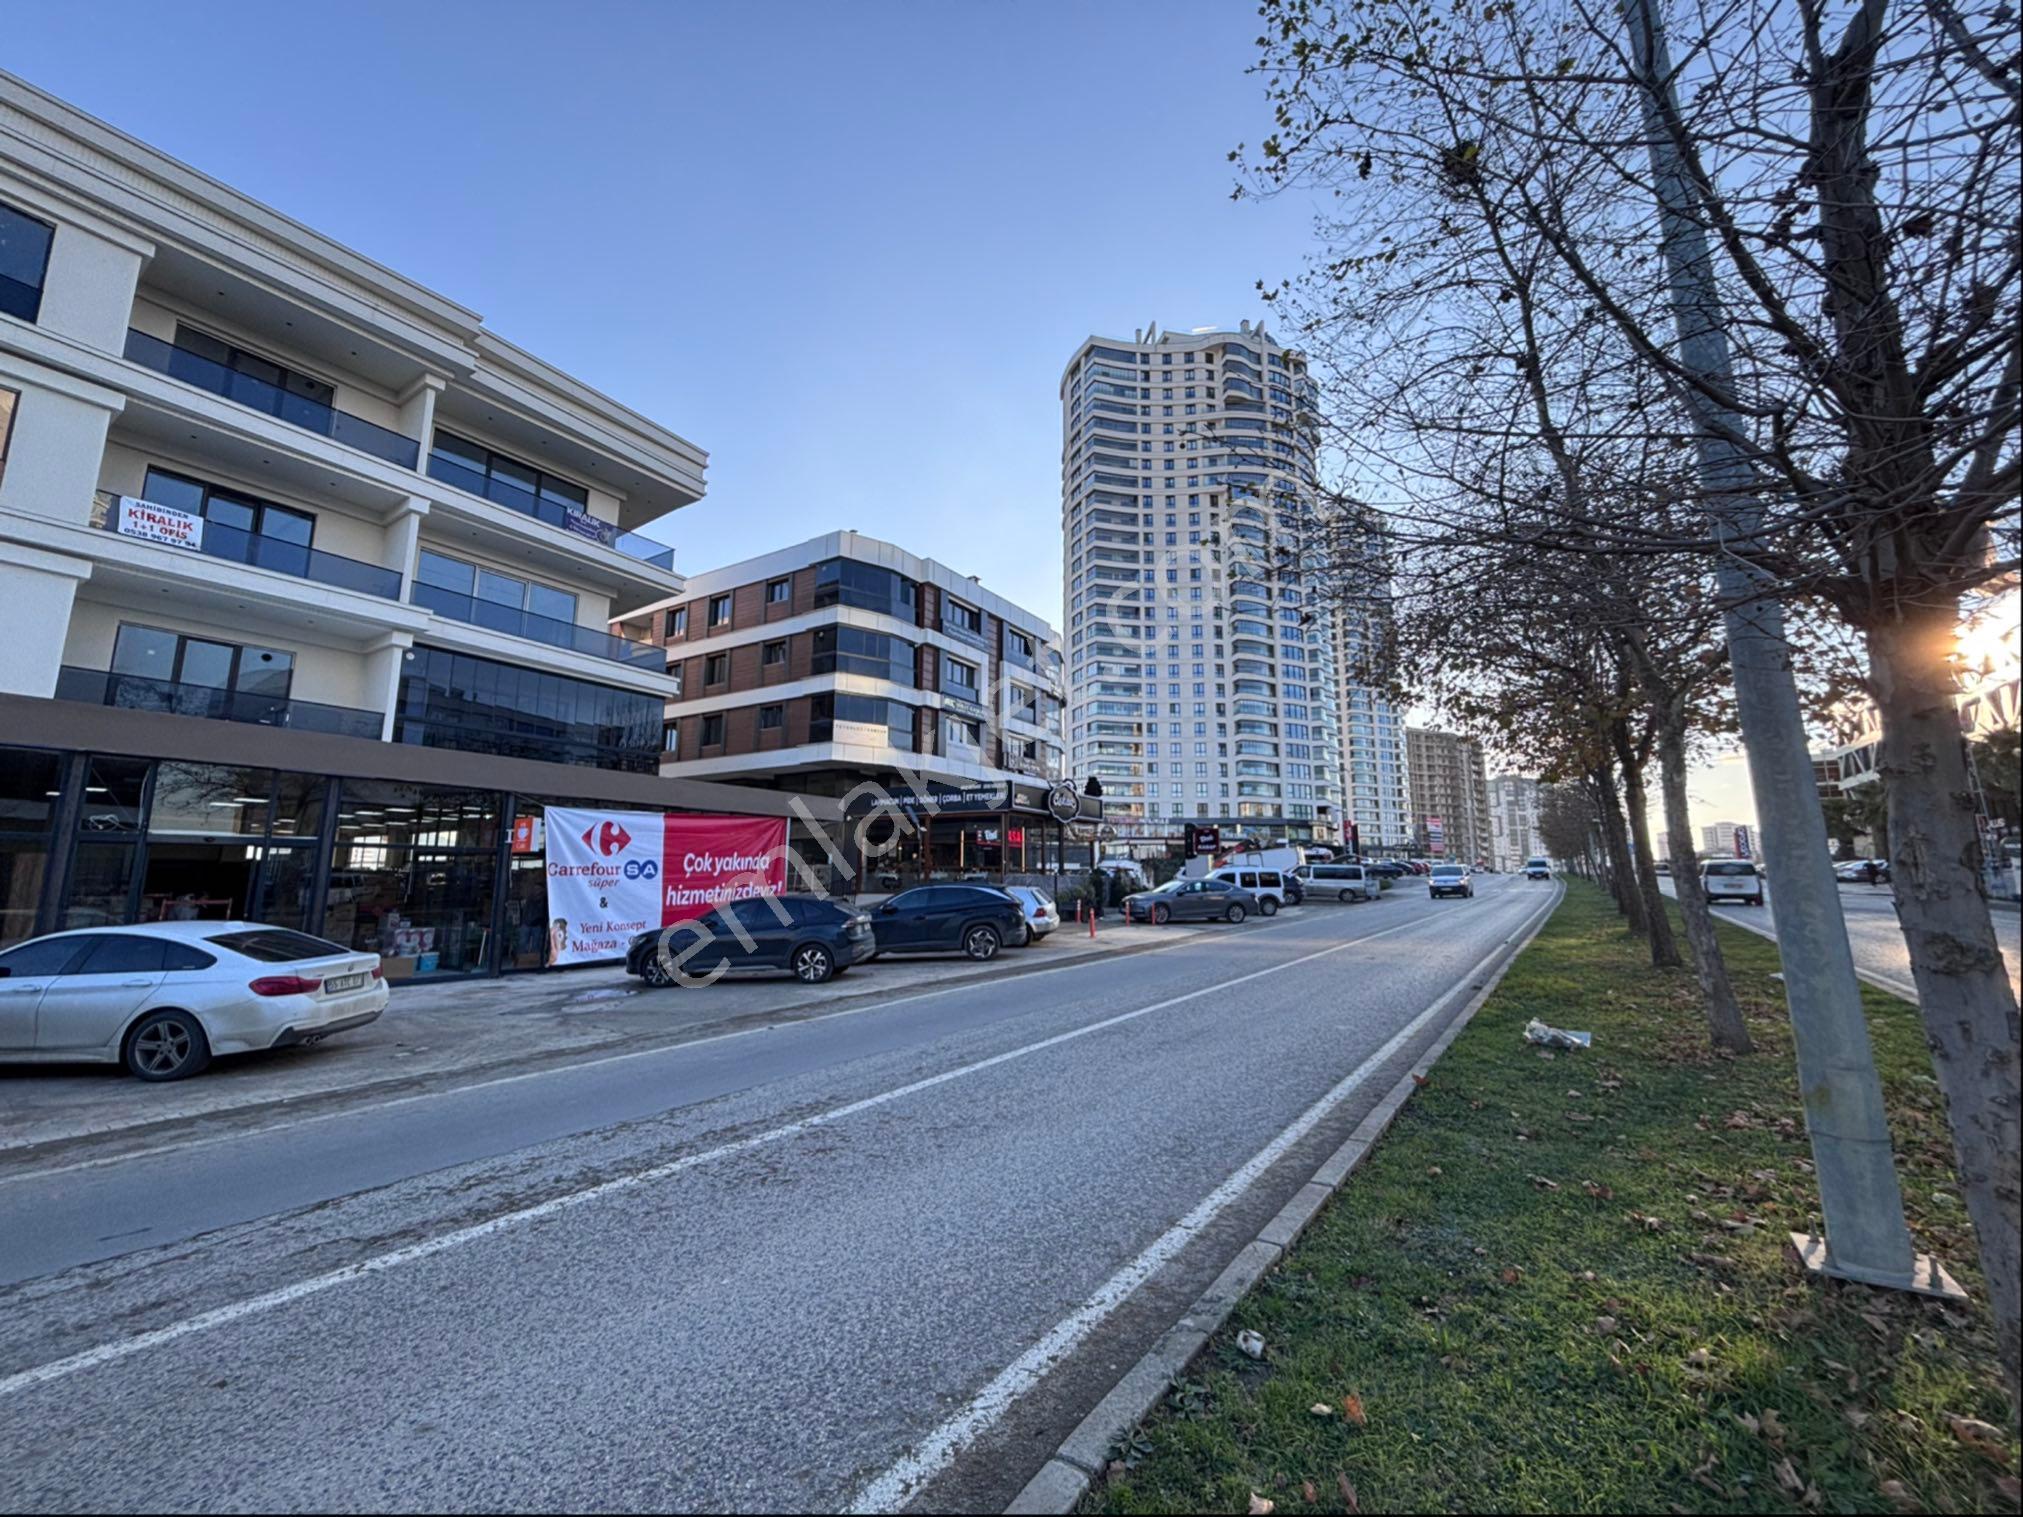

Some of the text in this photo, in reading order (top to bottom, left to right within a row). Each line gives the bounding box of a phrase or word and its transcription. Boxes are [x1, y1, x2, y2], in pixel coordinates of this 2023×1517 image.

[128, 508, 194, 531] KİRALIK
[547, 861, 621, 877] Carrefour
[684, 852, 770, 878] Çok yakında
[588, 877, 620, 891] süper
[599, 897, 608, 908] &
[580, 919, 647, 934] Yeni Konsept
[571, 937, 617, 954] Mağaza
